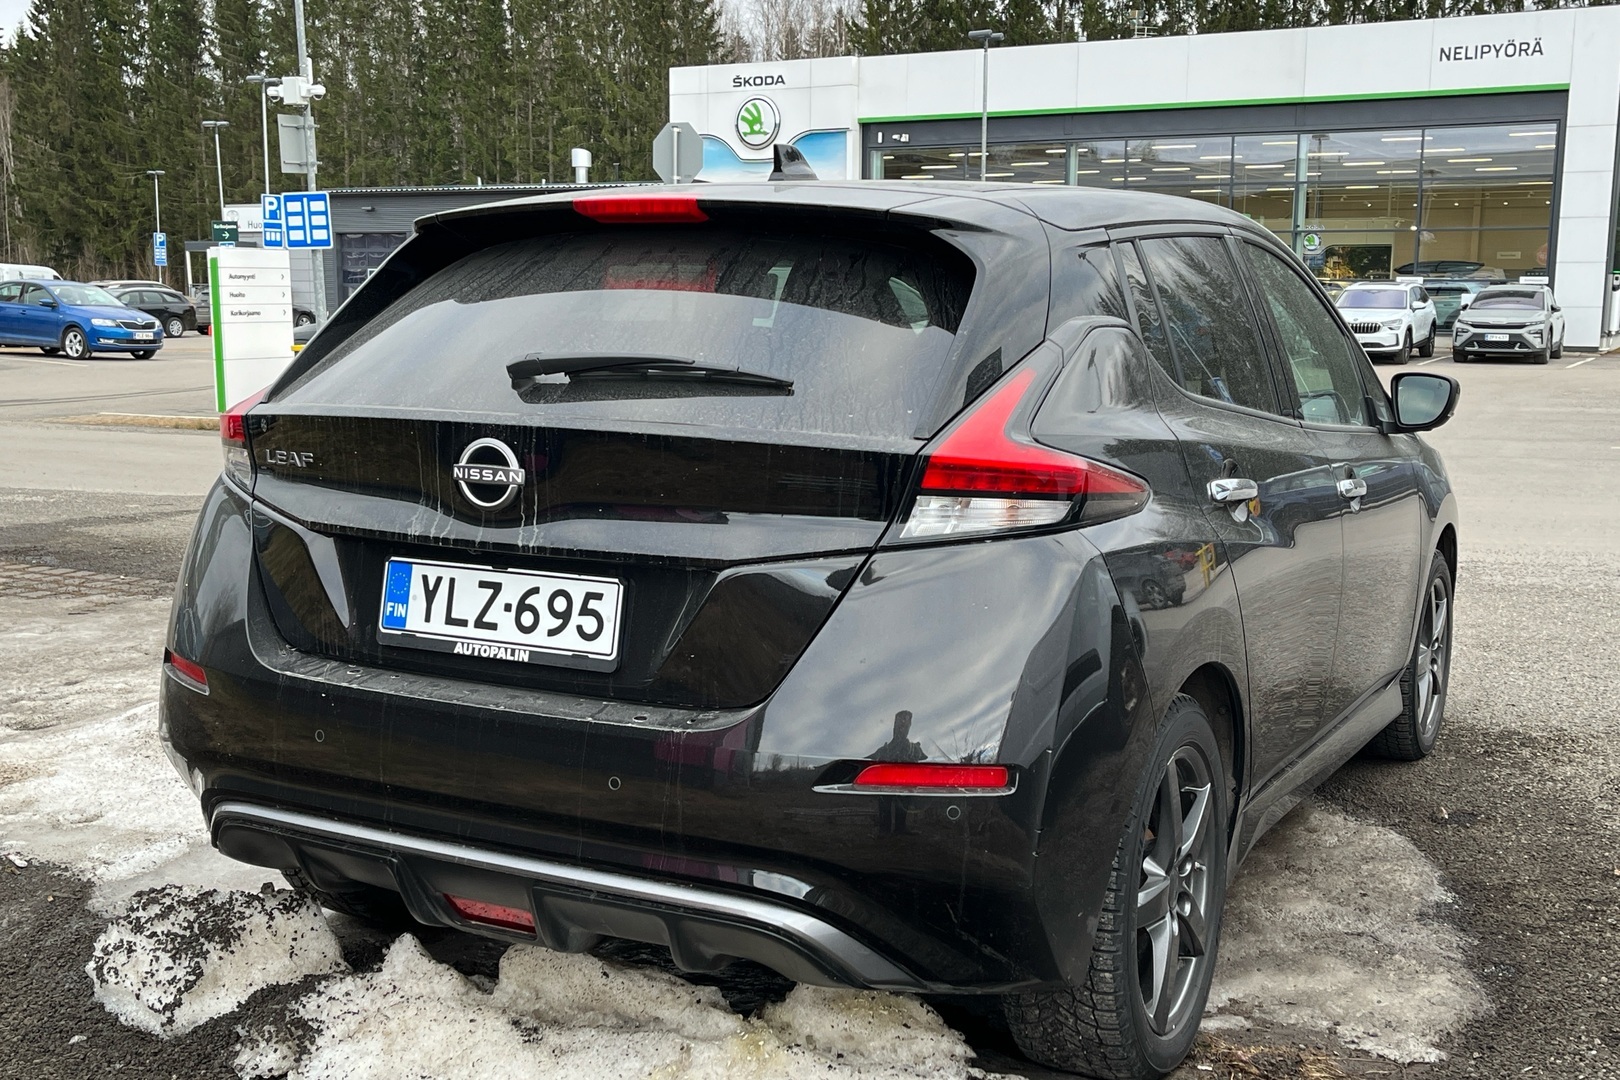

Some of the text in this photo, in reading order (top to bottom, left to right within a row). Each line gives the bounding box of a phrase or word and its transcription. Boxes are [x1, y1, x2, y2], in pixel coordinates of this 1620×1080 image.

[1439, 37, 1544, 62] NELIPYÖRÄ
[732, 74, 786, 88] ŠKODA
[265, 197, 278, 219] P
[157, 235, 164, 246] P
[228, 273, 256, 281] Automyynti
[265, 448, 314, 468] LEAF
[453, 466, 523, 483] NISSAN
[386, 573, 605, 642] FIN YLZ-695
[453, 641, 530, 662] AUTOPALIN
